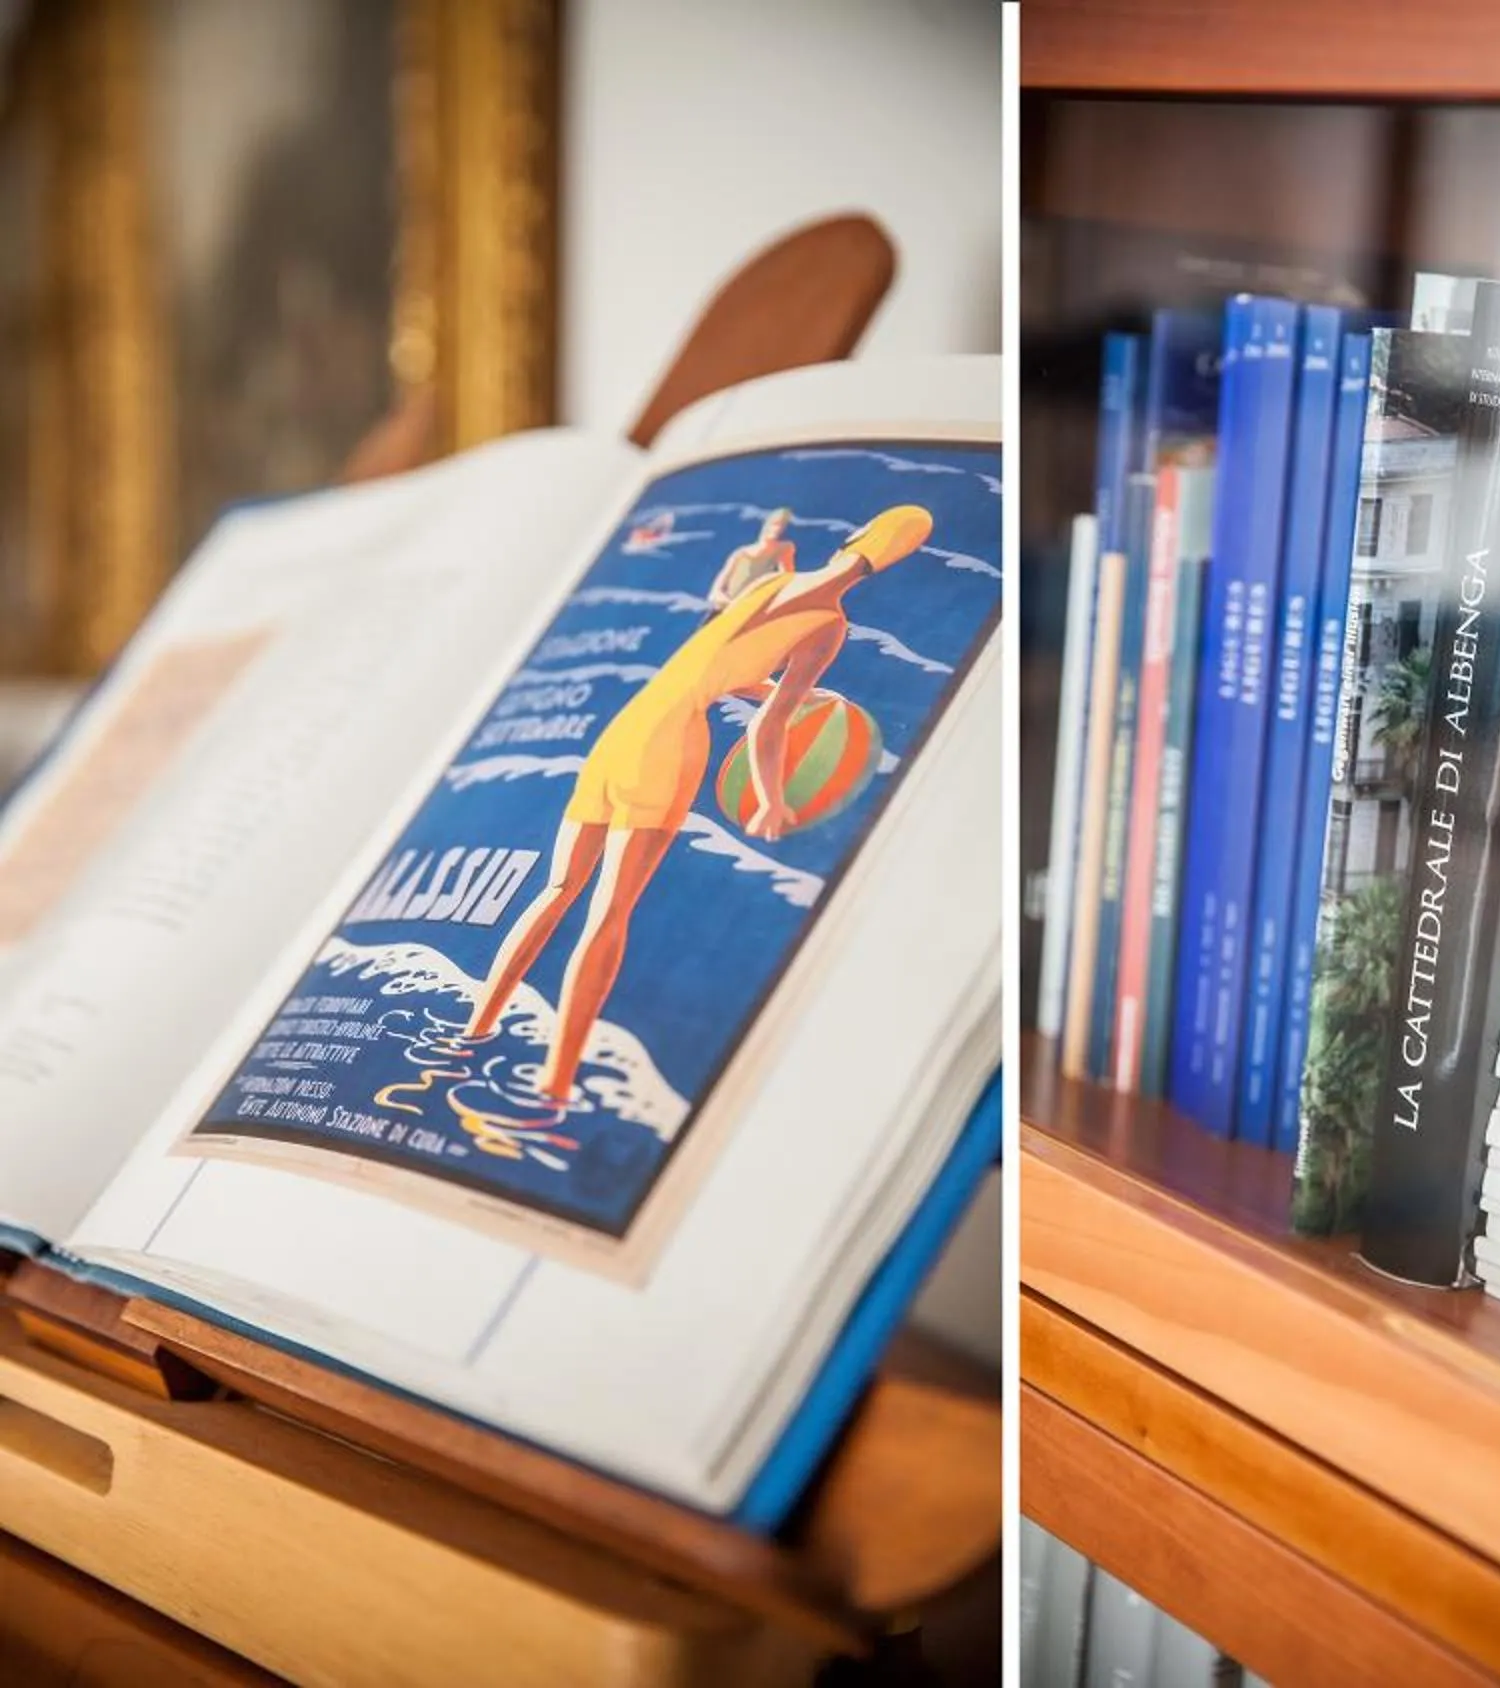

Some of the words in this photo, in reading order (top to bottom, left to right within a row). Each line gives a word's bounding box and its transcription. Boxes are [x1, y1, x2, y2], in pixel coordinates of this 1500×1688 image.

[1444, 547, 1491, 736] ALBENGA
[1434, 747, 1464, 795] DI
[1402, 809, 1456, 1067] CATTEDRALE
[326, 1105, 391, 1139] STAZIONE
[1394, 1081, 1423, 1131] LA
